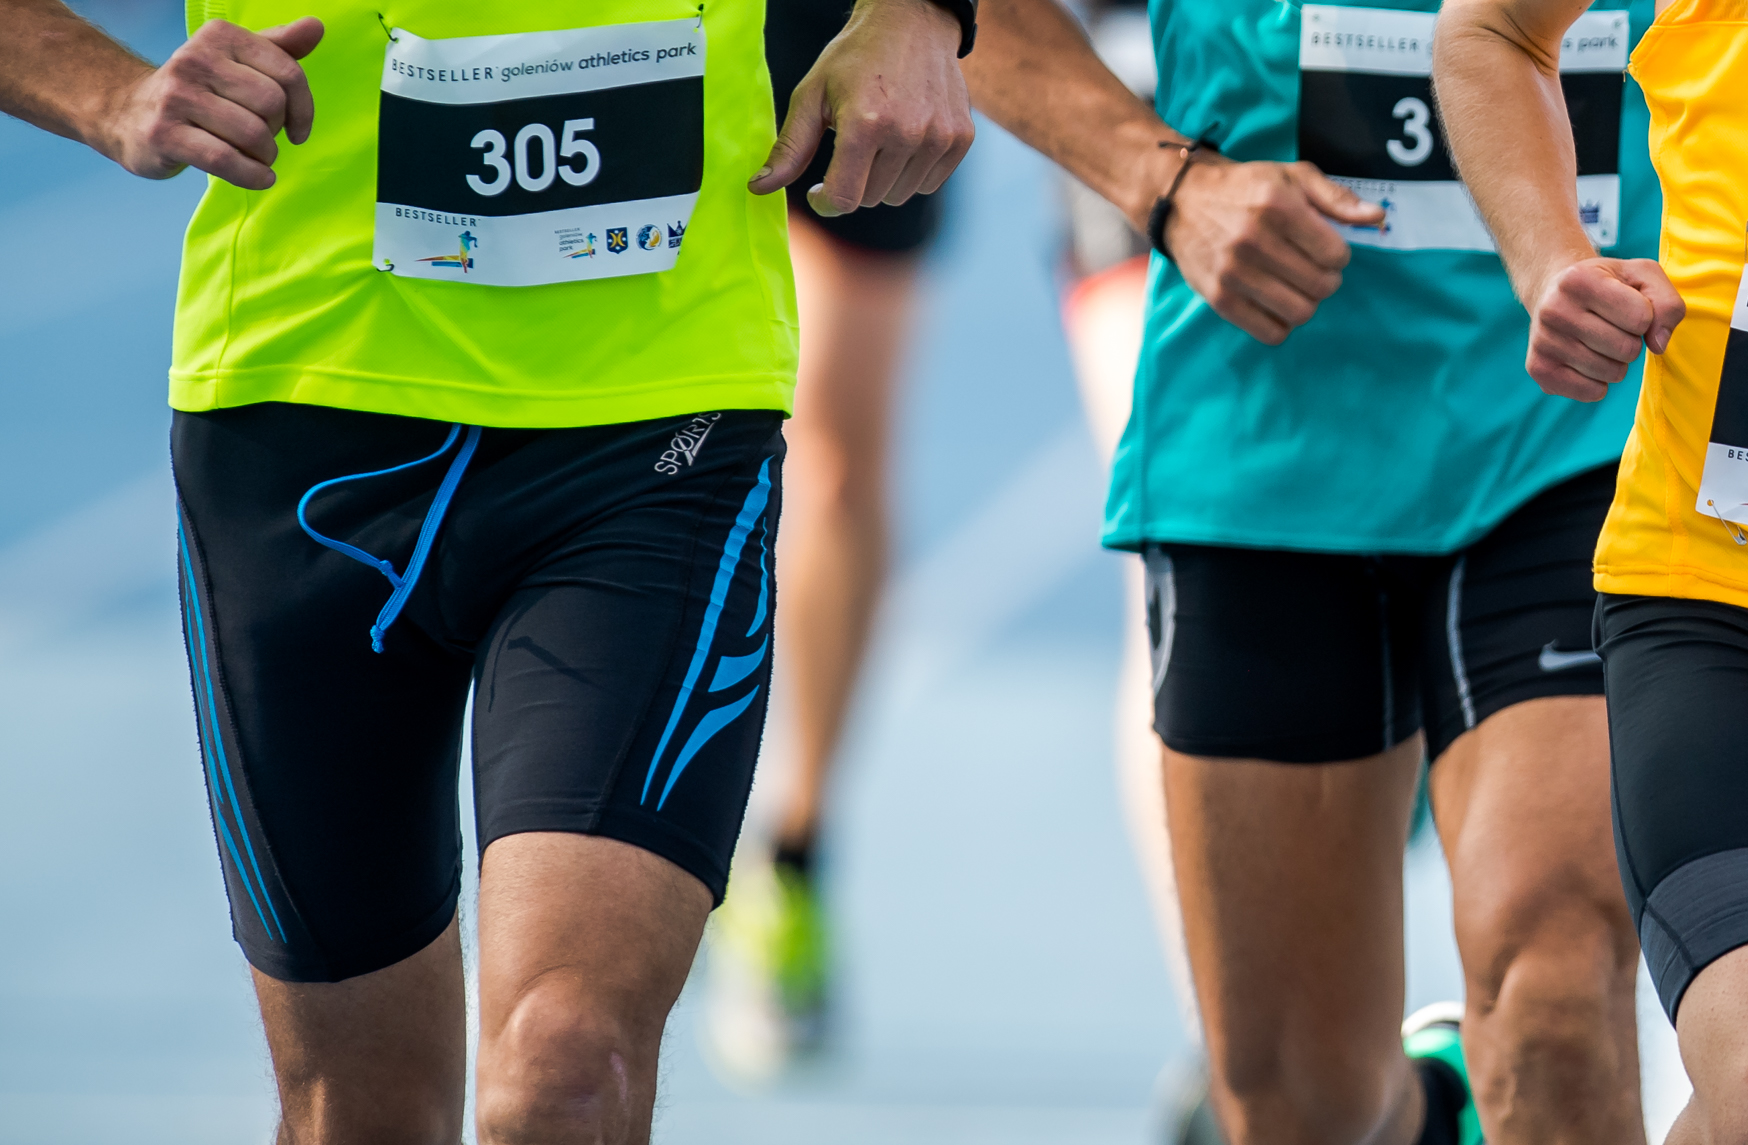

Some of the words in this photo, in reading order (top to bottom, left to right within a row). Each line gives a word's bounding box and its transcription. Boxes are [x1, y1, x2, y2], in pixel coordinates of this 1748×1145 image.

[1311, 31, 1419, 52] BESTSELLER
[391, 58, 494, 83] BESTSELLER
[501, 58, 574, 82] goleniów
[578, 47, 650, 70] athletics
[656, 42, 697, 63] park
[465, 117, 601, 197] 305
[395, 208, 477, 227] BESTSELLER
